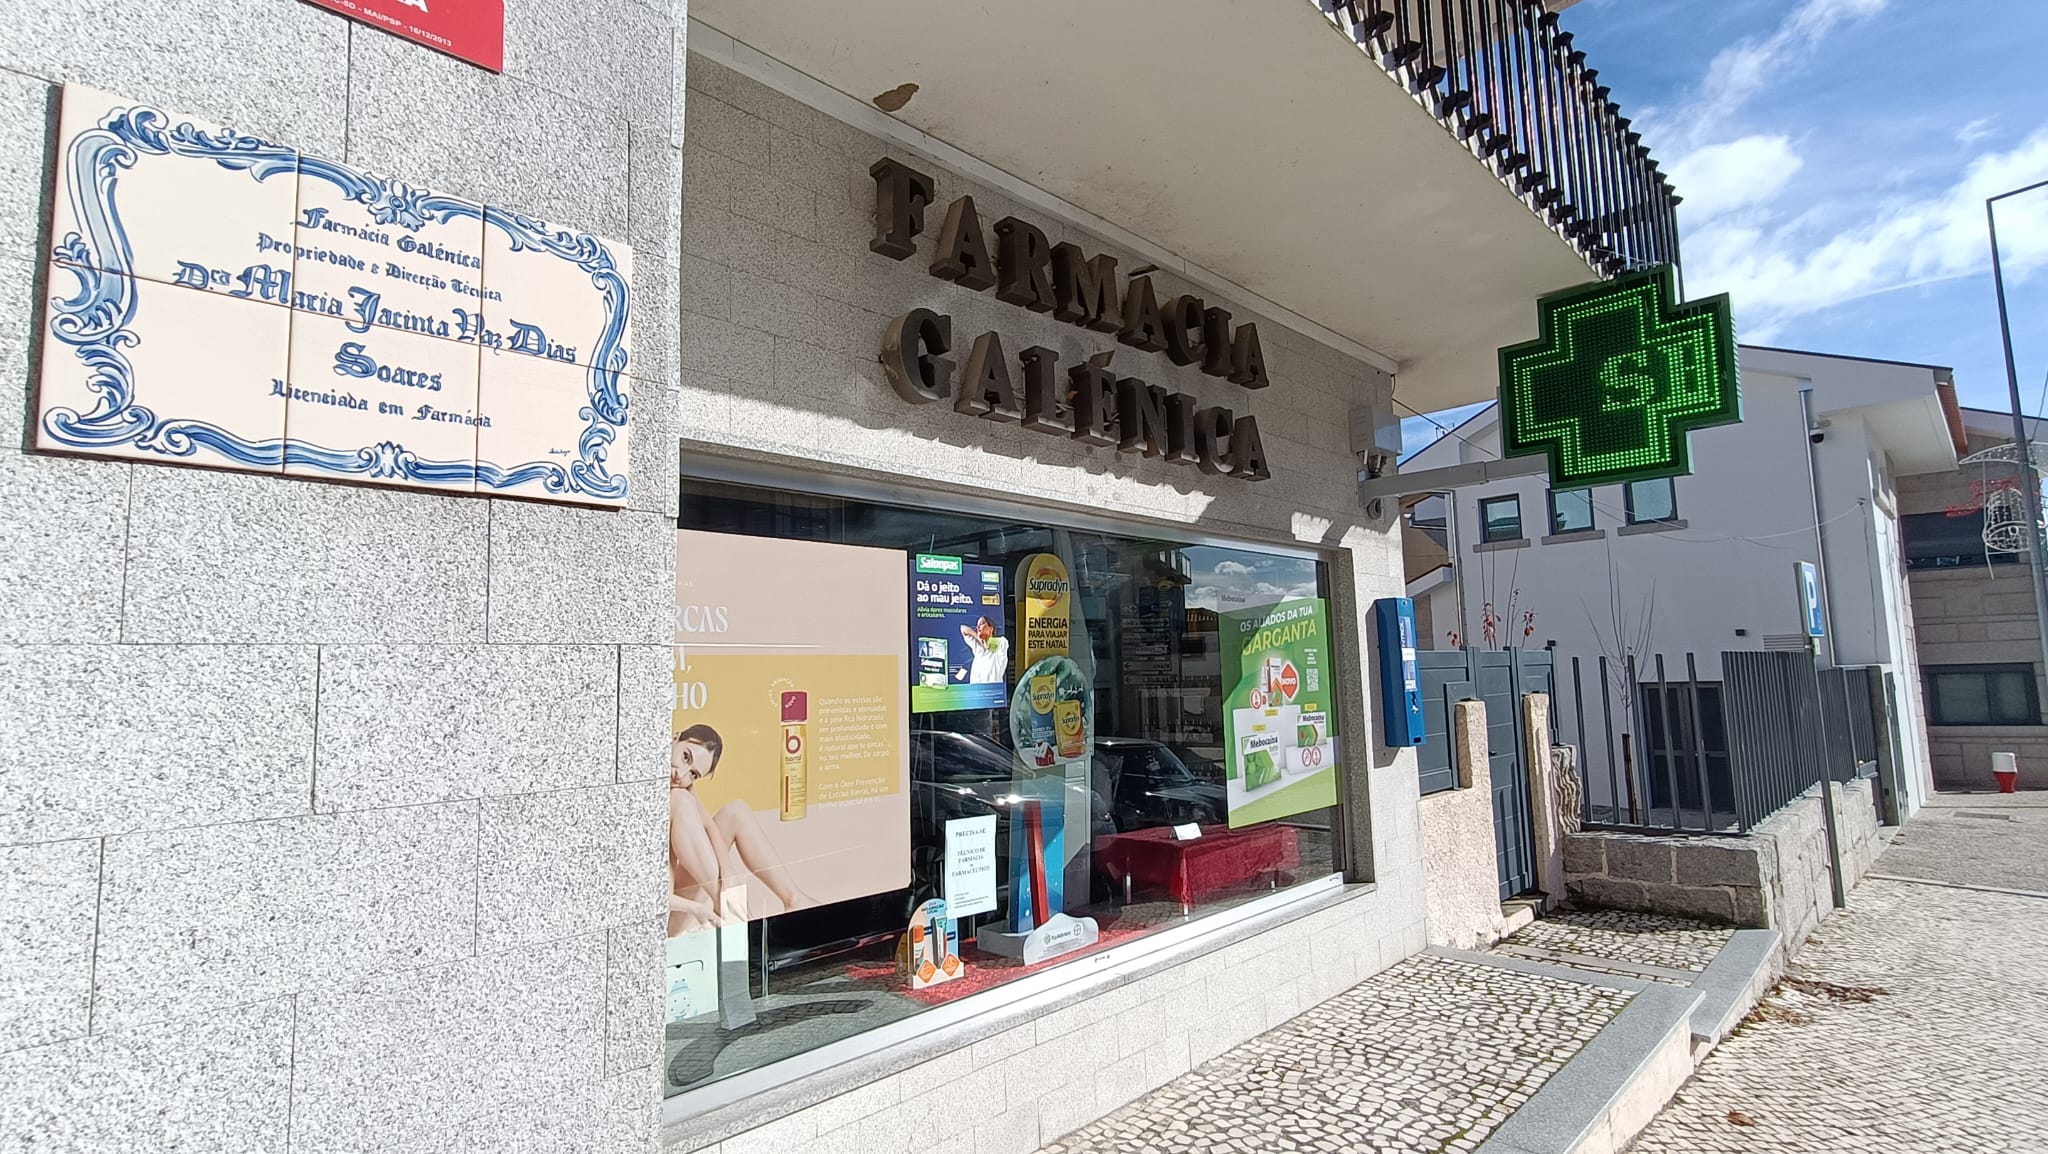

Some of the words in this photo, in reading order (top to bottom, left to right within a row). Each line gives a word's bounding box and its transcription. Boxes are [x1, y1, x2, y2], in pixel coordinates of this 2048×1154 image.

[290, 207, 390, 247] Farmácia
[396, 235, 481, 270] Galénica
[256, 231, 365, 271] Propriedade
[370, 262, 380, 275] e
[450, 278, 503, 303] Técnica
[869, 156, 1270, 390] FARMÁCIA
[229, 264, 344, 316] Maria
[345, 286, 450, 338] Jacinta
[507, 318, 577, 363] Dias
[333, 342, 442, 392] Soares
[269, 378, 369, 411] Licenciada
[378, 401, 404, 416] em
[411, 404, 492, 428] Farmácia
[879, 308, 1271, 482] GALÉNICA
[920, 556, 959, 571] Salonpas
[916, 580, 930, 591] Dá
[931, 583, 938, 591] o
[938, 581, 960, 594] jeito
[916, 594, 929, 603] ao
[930, 595, 950, 604] mau
[950, 593, 974, 605] jeito.
[1029, 577, 1068, 594] Supradyn
[1804, 571, 1817, 629] P
[1028, 617, 1068, 629] ENERGIA
[1240, 620, 1252, 633] OS
[1252, 612, 1287, 630] ALIADOS
[1287, 609, 1298, 621] DA
[1299, 605, 1314, 618] TUA
[1028, 629, 1045, 638] PARA
[1045, 630, 1067, 639] VIAJAR
[1028, 639, 1045, 649] ESTE
[1045, 640, 1067, 649] NATAL
[1242, 618, 1317, 657] GARGANTA
[818, 696, 843, 706] Quando
[957, 849, 979, 857] TÉCNICO
